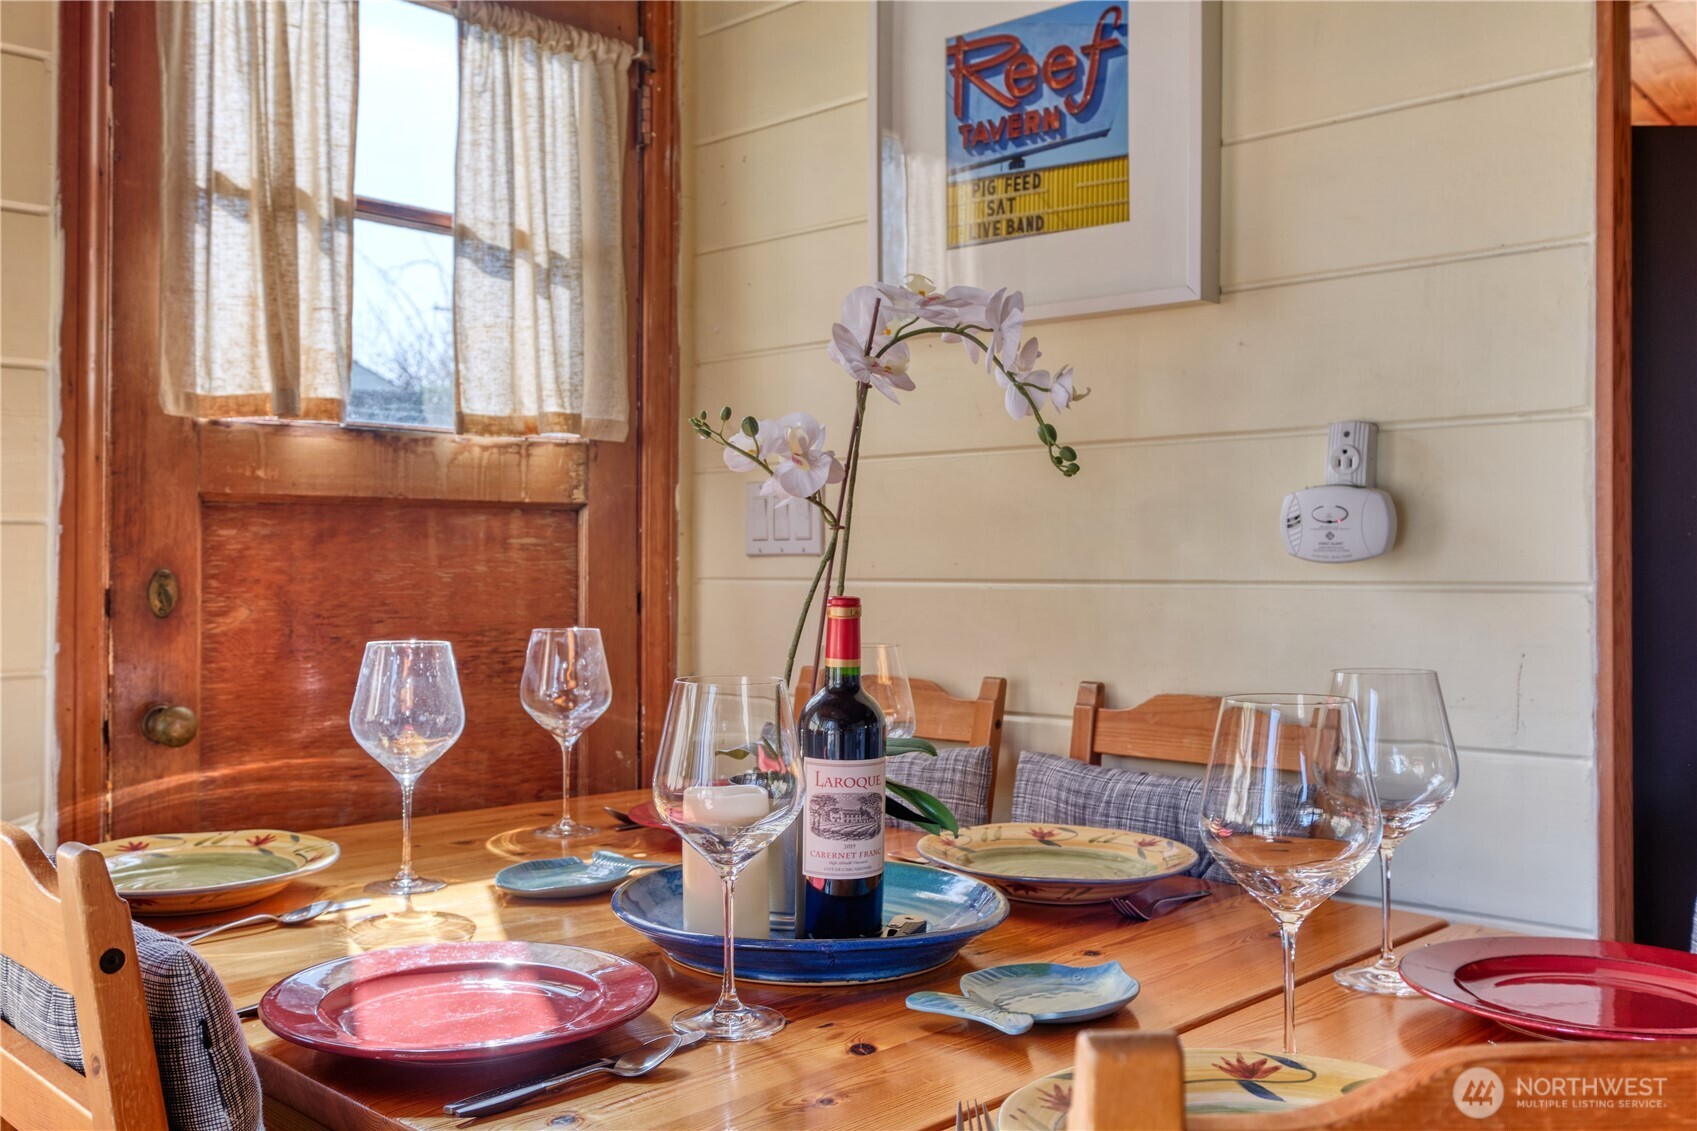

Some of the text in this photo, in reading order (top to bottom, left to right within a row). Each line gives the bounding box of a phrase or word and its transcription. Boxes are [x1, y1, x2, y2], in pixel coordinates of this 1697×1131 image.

[947, 5, 1122, 119] Reef
[958, 106, 1060, 148] TAVERN
[972, 173, 1041, 198] PIG FEED
[986, 198, 1016, 217] SAT
[969, 215, 1044, 240] LIVE BAND
[815, 771, 881, 789] LAROQUE
[810, 848, 881, 860] CABERNET FRANC
